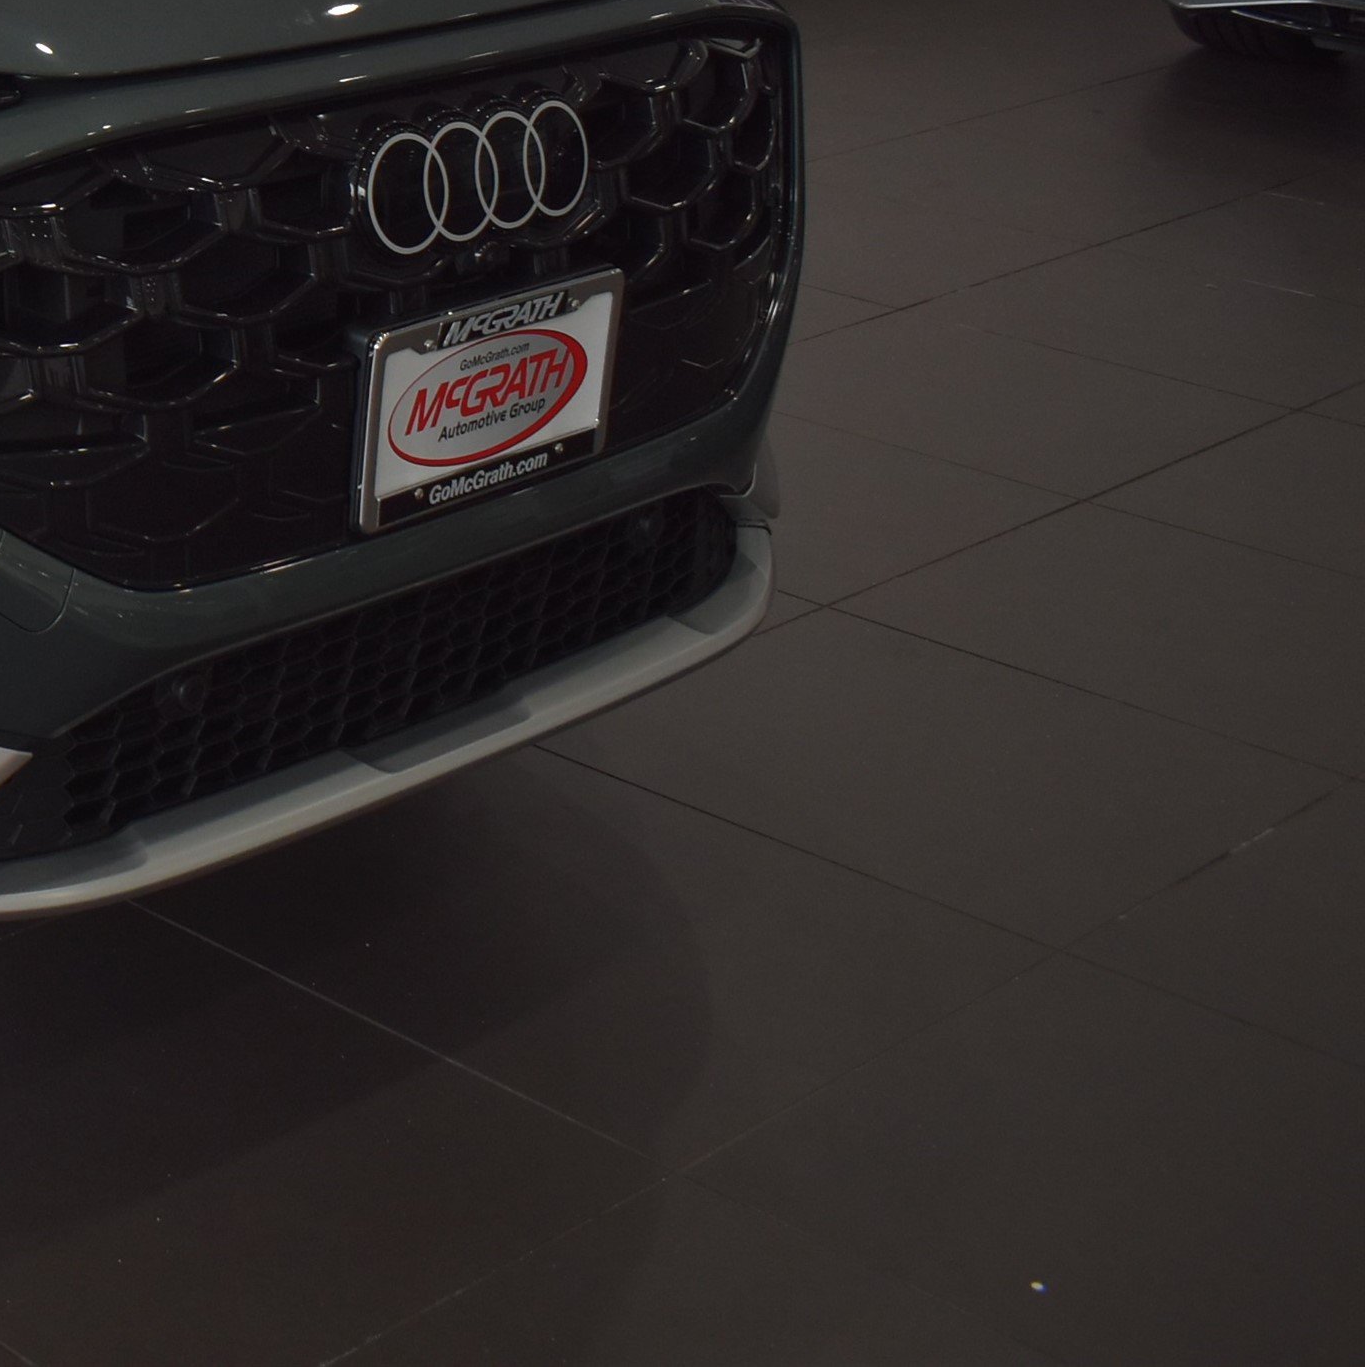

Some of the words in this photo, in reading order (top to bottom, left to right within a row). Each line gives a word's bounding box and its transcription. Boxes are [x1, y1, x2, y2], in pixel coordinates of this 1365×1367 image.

[459, 342, 530, 372] GoMcGrath.com
[437, 410, 506, 443] Automotive
[509, 397, 546, 419] Group
[428, 452, 549, 505] GoMcGrath.com
